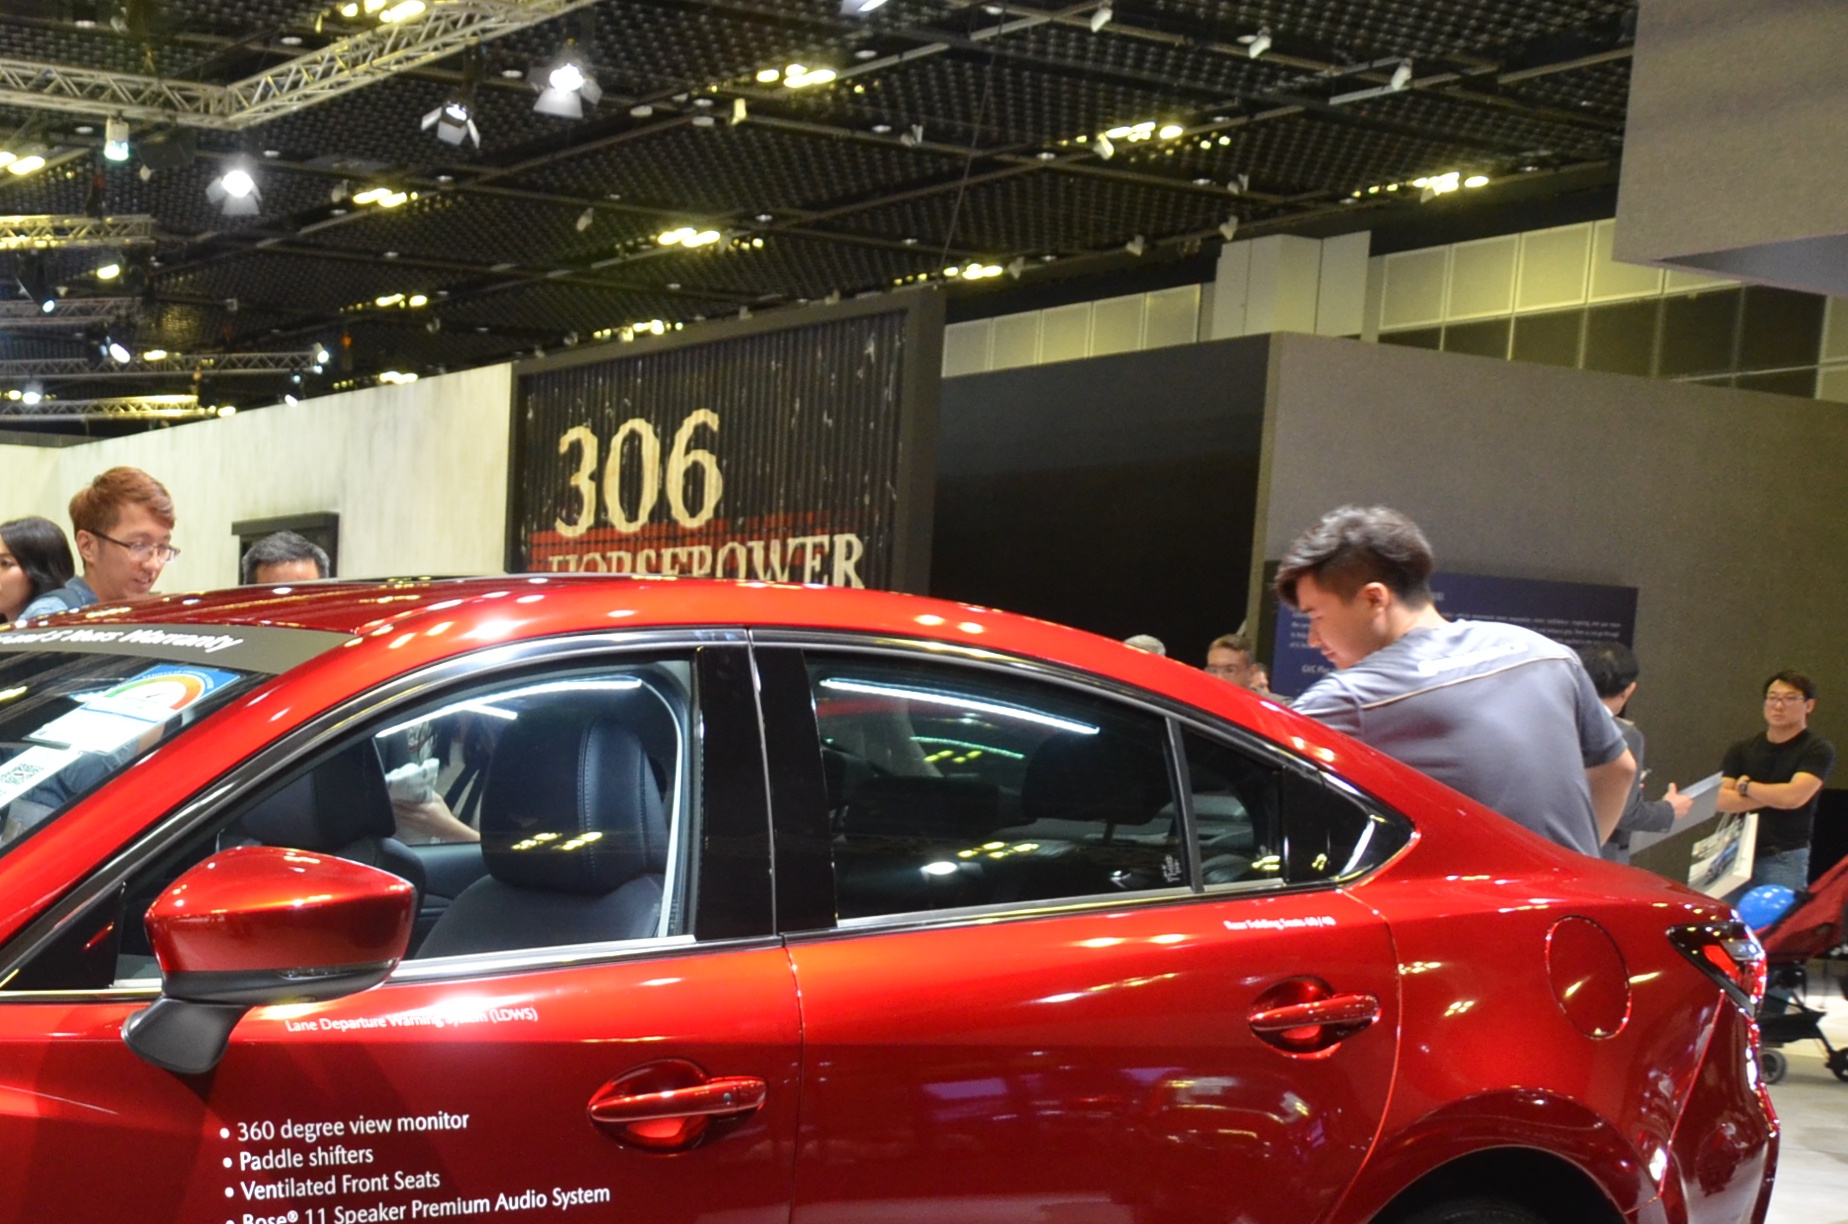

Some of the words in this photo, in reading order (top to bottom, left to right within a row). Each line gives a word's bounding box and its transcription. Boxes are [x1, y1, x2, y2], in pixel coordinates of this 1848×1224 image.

[555, 409, 723, 538] 306
[118, 628, 244, 654] Warranty
[285, 1019, 317, 1032] Lane
[319, 1017, 387, 1032] Departure
[489, 1004, 539, 1024] (LDWS)
[237, 1121, 275, 1142] 360
[280, 1118, 345, 1144] degree
[348, 1115, 392, 1135] view
[397, 1111, 469, 1133] monitor
[239, 1148, 303, 1171] Paddle
[308, 1146, 374, 1166] shifters
[240, 1175, 337, 1201] Ventilated
[342, 1172, 389, 1193] Front
[394, 1170, 441, 1190] Seats
[411, 1197, 490, 1219] Premium
[494, 1190, 548, 1211] Audio
[552, 1185, 611, 1210] System
